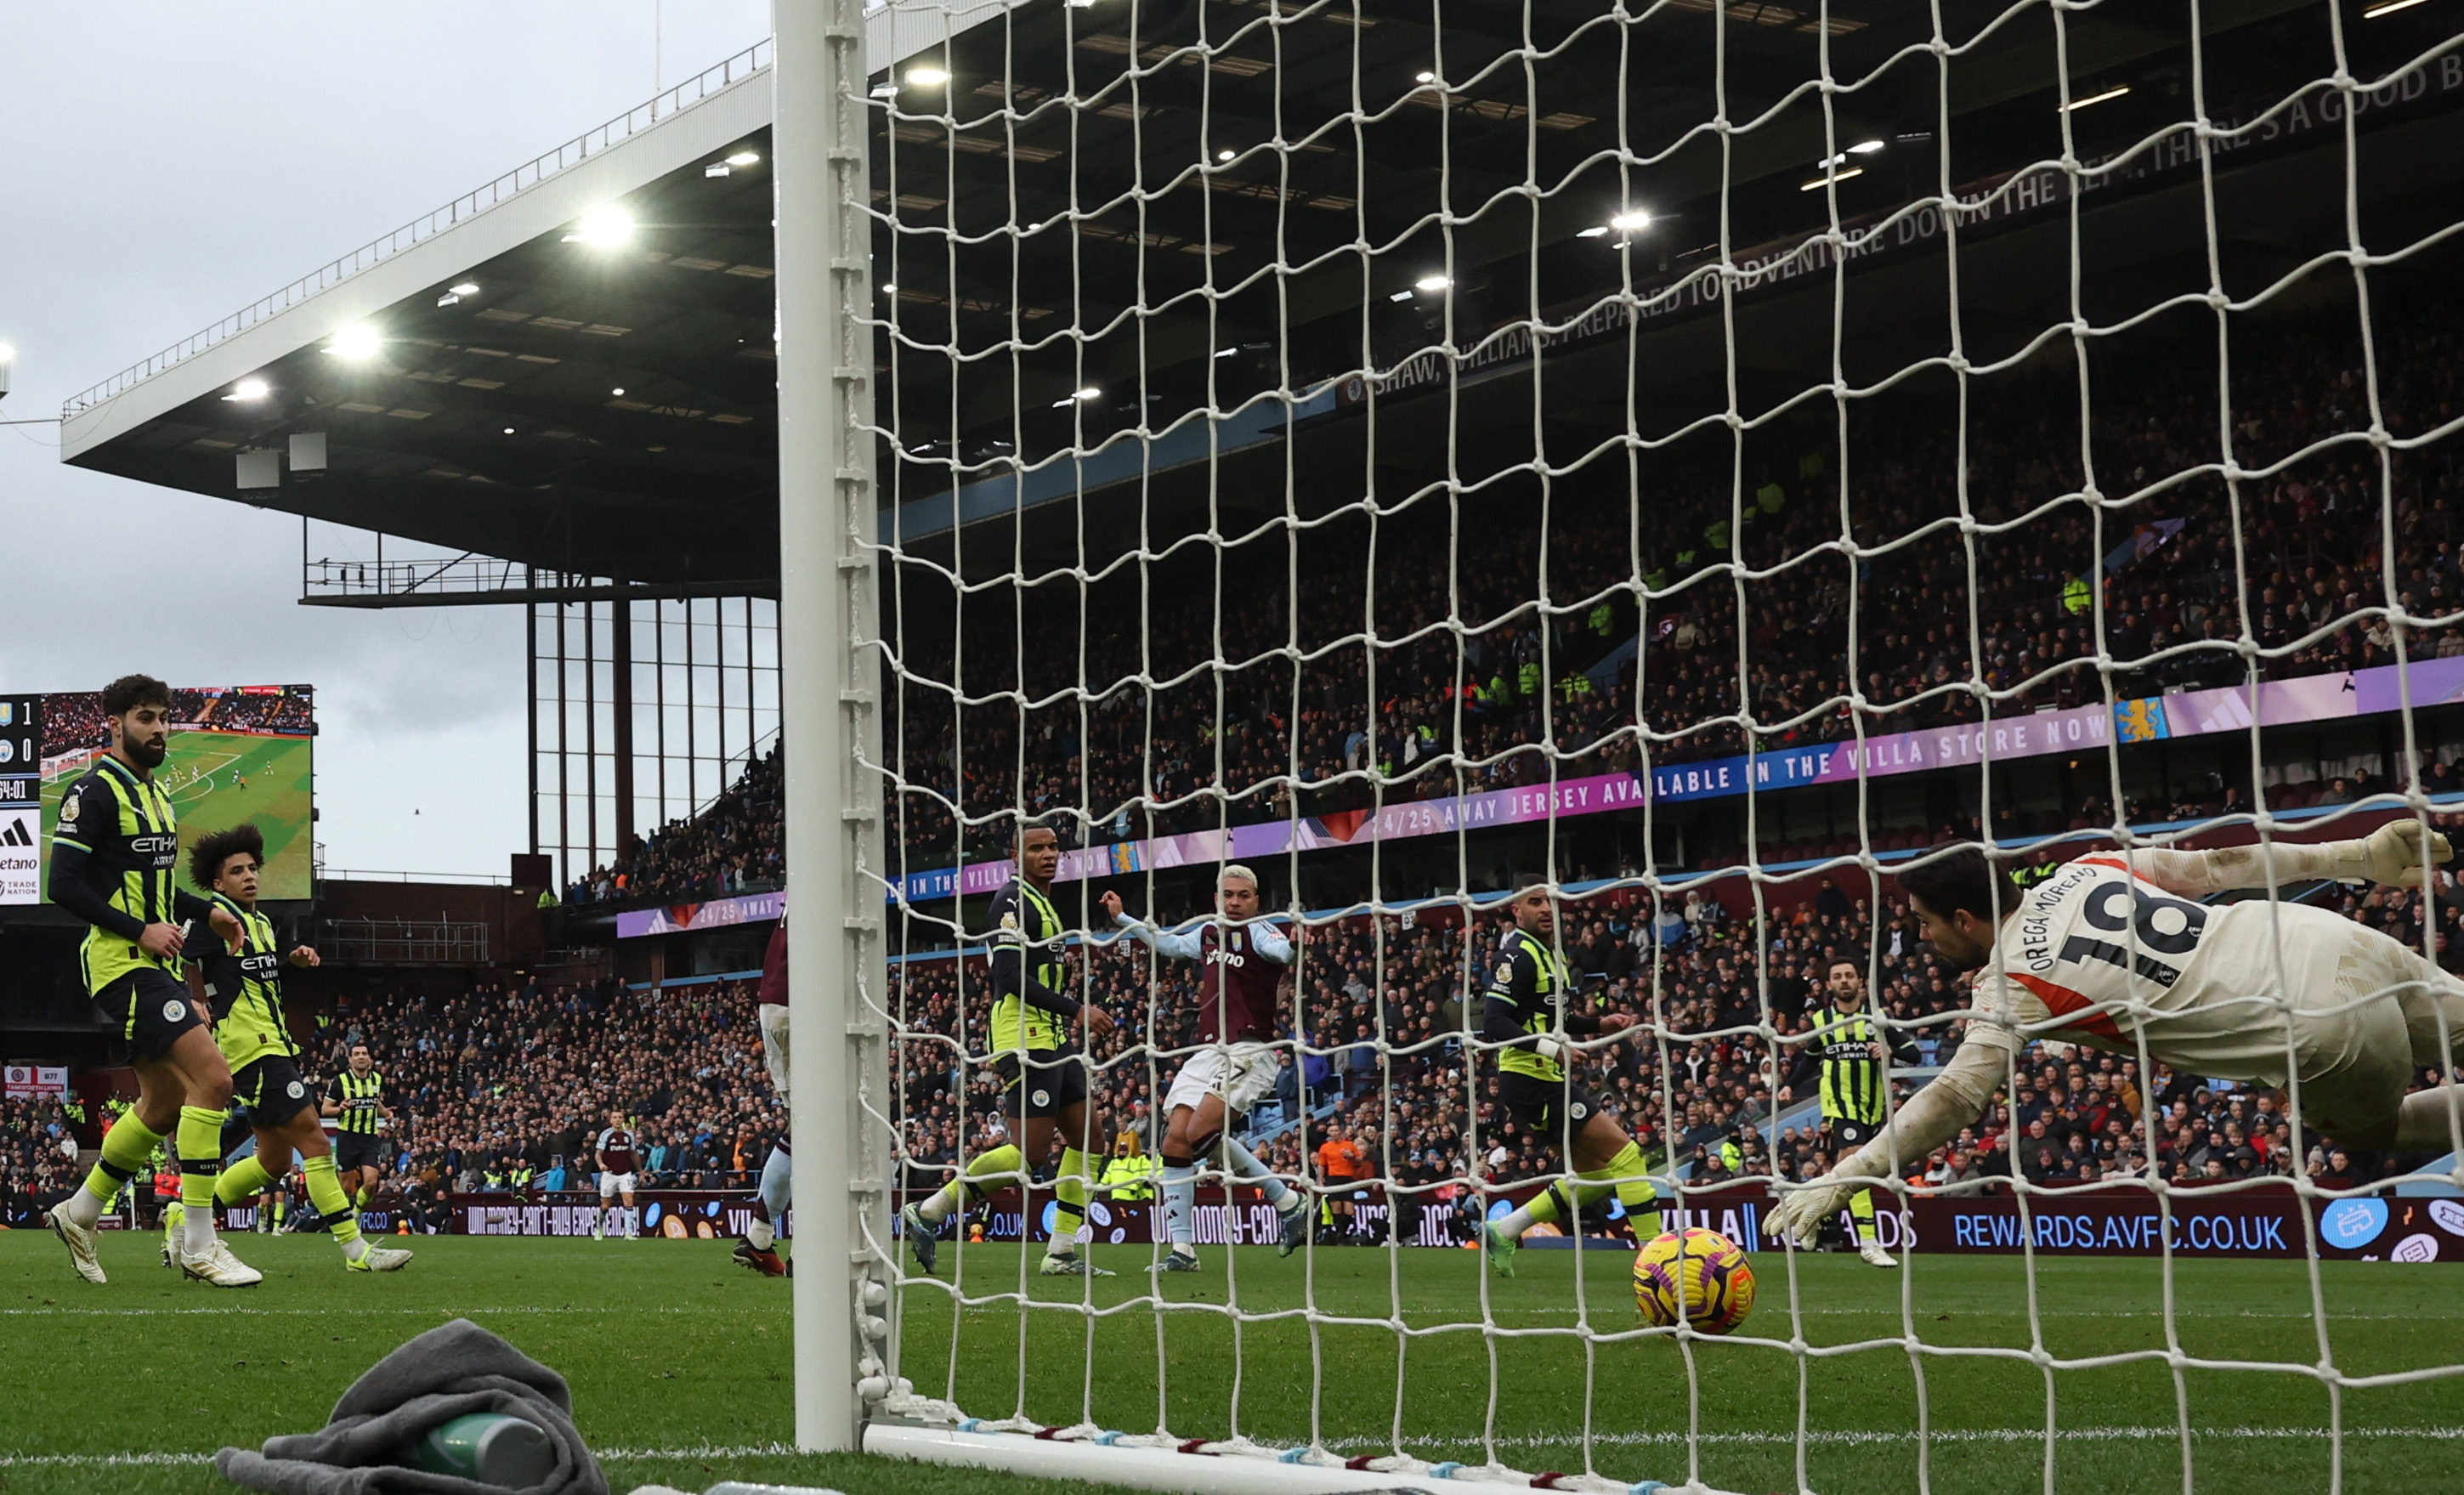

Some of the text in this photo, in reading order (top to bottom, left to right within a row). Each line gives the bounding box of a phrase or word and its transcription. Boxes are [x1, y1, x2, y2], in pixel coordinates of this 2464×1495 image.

[1562, 285, 1682, 343] PREPARED
[1689, 276, 1721, 306] TO
[1726, 228, 1886, 294] ADVENTURE
[1896, 194, 1991, 246] DOWN
[1998, 171, 2056, 216] THE
[2287, 96, 2313, 135] A
[2320, 70, 2427, 122] GOOD
[23, 701, 31, 725] 1
[23, 738, 31, 762] 0
[1445, 799, 1496, 825] AWAY
[1510, 786, 1588, 816] JERSEY
[1745, 761, 1770, 784] IN
[1785, 752, 1831, 779] THE
[1846, 739, 1923, 772] VILLA
[1940, 725, 2028, 759] STORE
[2046, 714, 2107, 745] NOW
[1075, 852, 1108, 871] NOW
[912, 879, 926, 896] IN
[935, 874, 960, 892] THE
[968, 866, 1011, 887] VILLA
[2031, 867, 2098, 915] MORENO
[700, 899, 773, 924] 24/25 AWAY
[2058, 881, 2208, 988] 18
[1837, 1051, 1869, 1060] AIRWAYS
[227, 1209, 252, 1228] VILLA
[1956, 1214, 2288, 1251] REWARDS.AVFC.CO.UK
